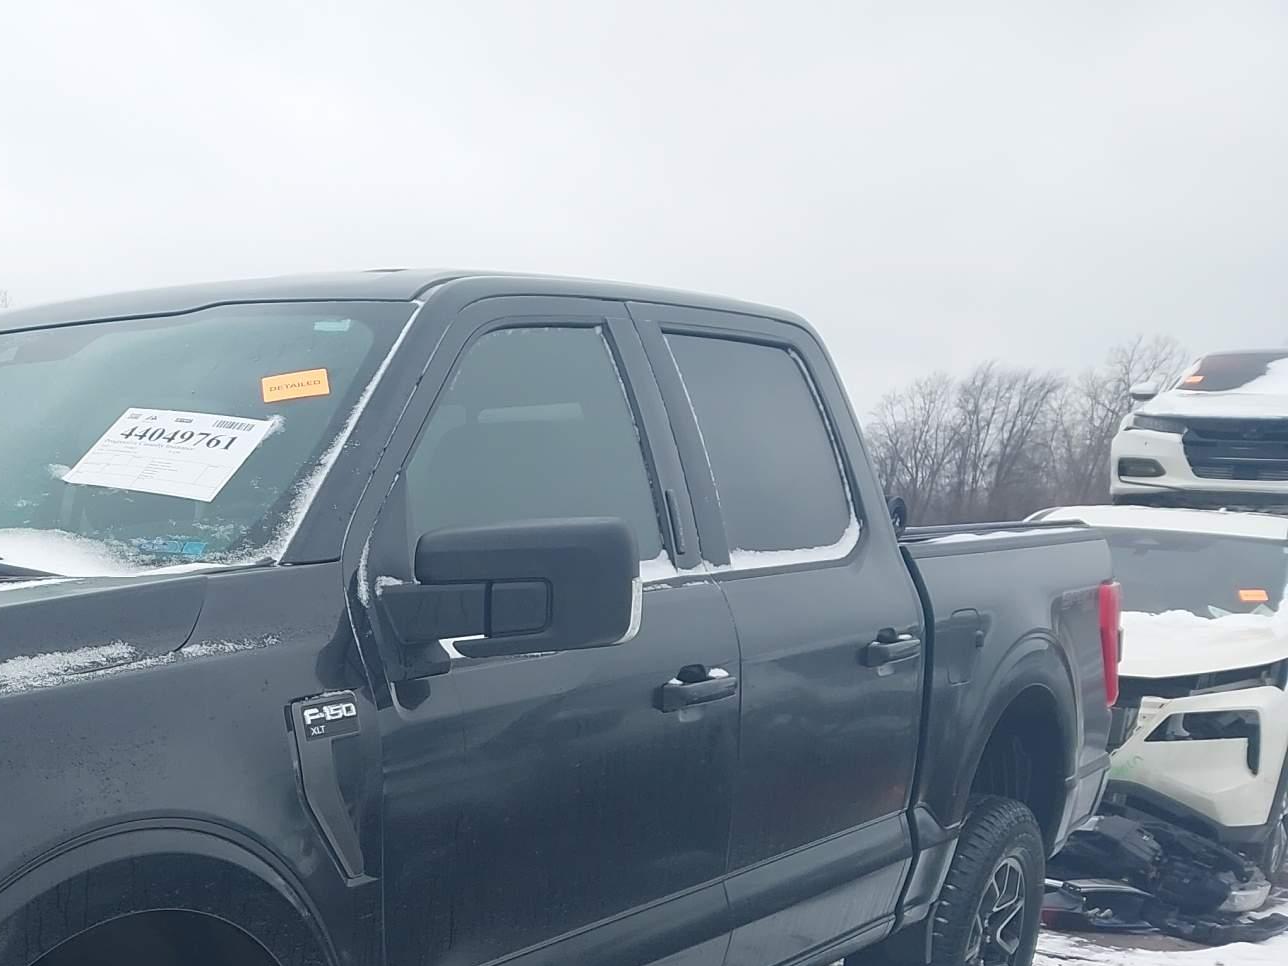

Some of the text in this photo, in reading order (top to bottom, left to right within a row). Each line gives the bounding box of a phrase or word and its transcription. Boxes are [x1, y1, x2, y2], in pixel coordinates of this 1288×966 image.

[269, 380, 321, 392] DETAILED
[121, 426, 238, 450] 44049761
[304, 703, 357, 725] F-150
[311, 725, 326, 736] XLT
